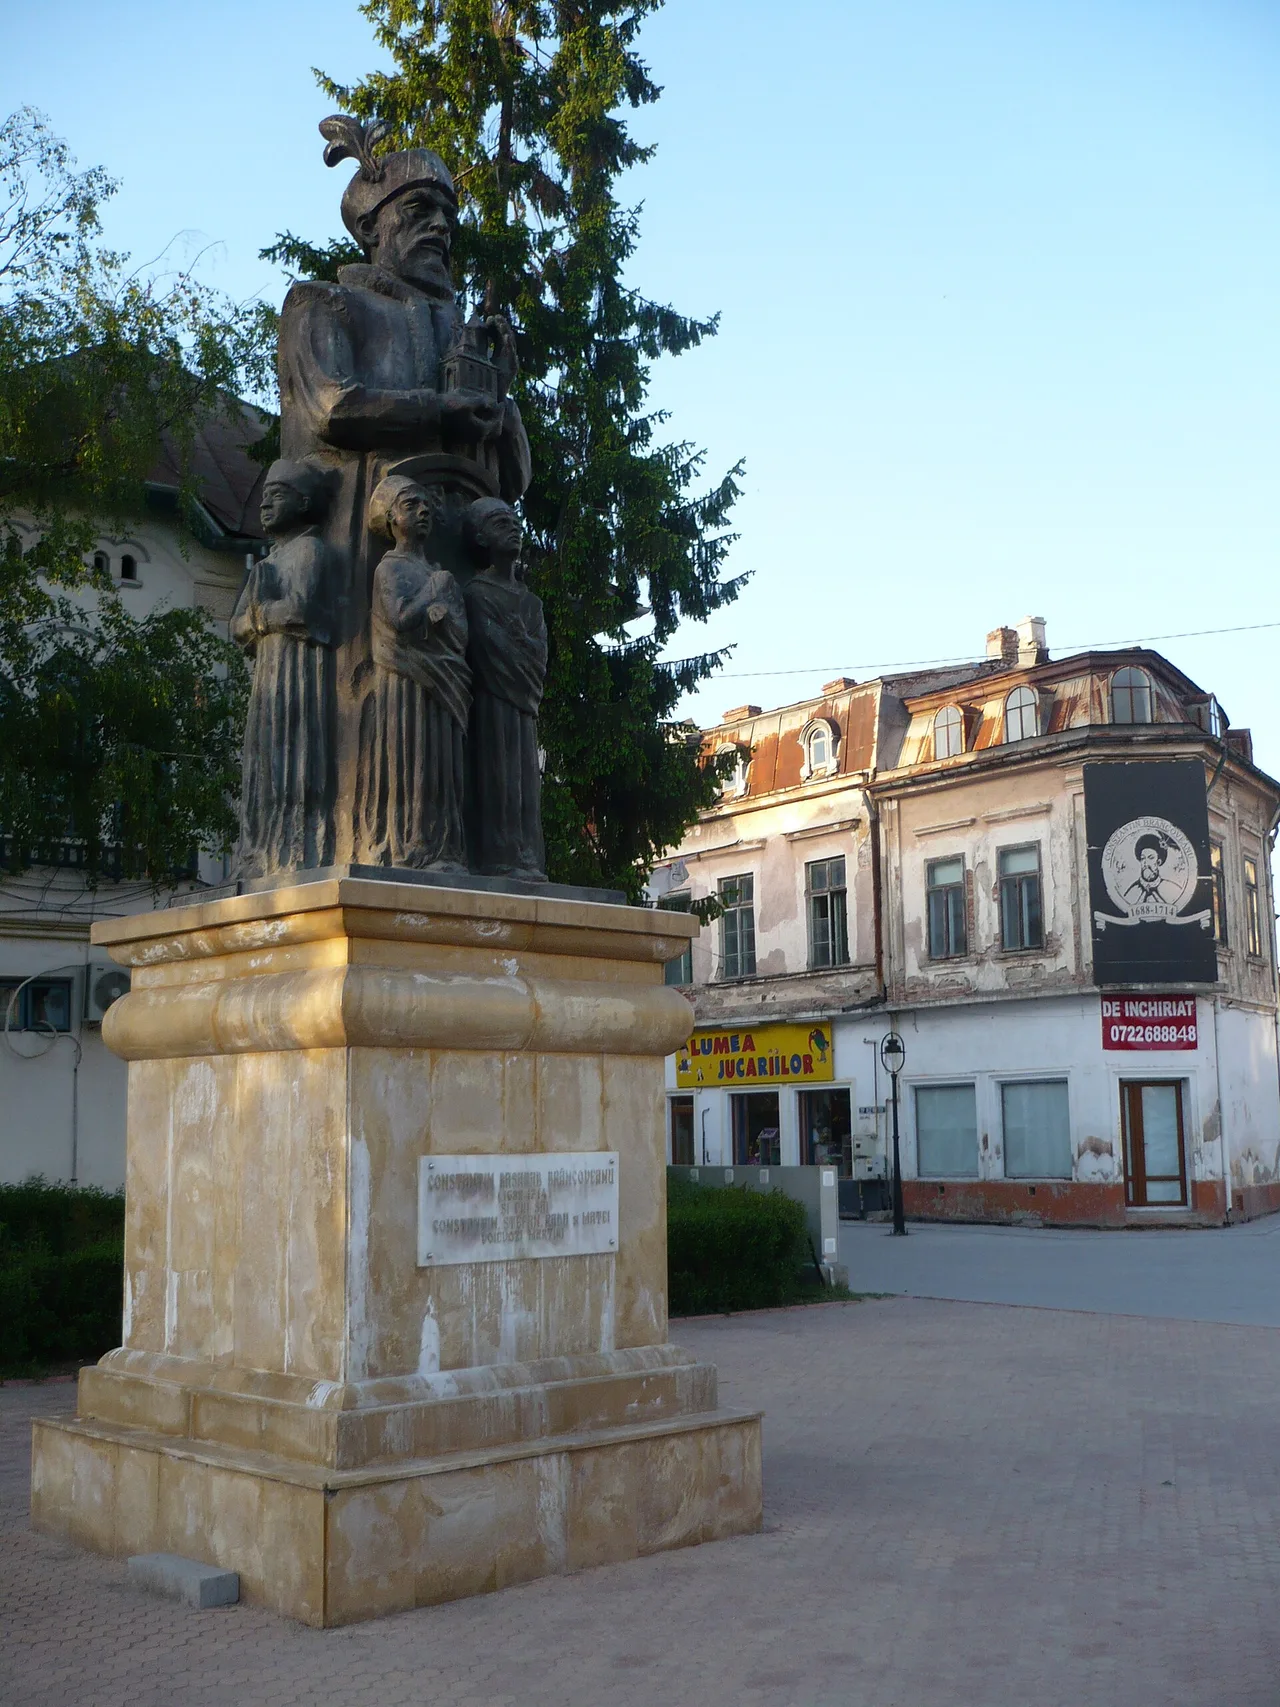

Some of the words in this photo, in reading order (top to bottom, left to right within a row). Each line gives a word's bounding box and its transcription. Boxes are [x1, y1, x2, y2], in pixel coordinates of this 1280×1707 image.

[1104, 822, 1140, 861] CONSTANTIN
[1130, 907, 1174, 917] 1688-1714
[1102, 1001, 1121, 1017] DE
[1124, 1001, 1194, 1017] INCHIRIAT
[1110, 1025, 1196, 1042] 0722688848
[690, 1034, 756, 1057] LUMEA
[717, 1053, 815, 1079] JUCARIILOR
